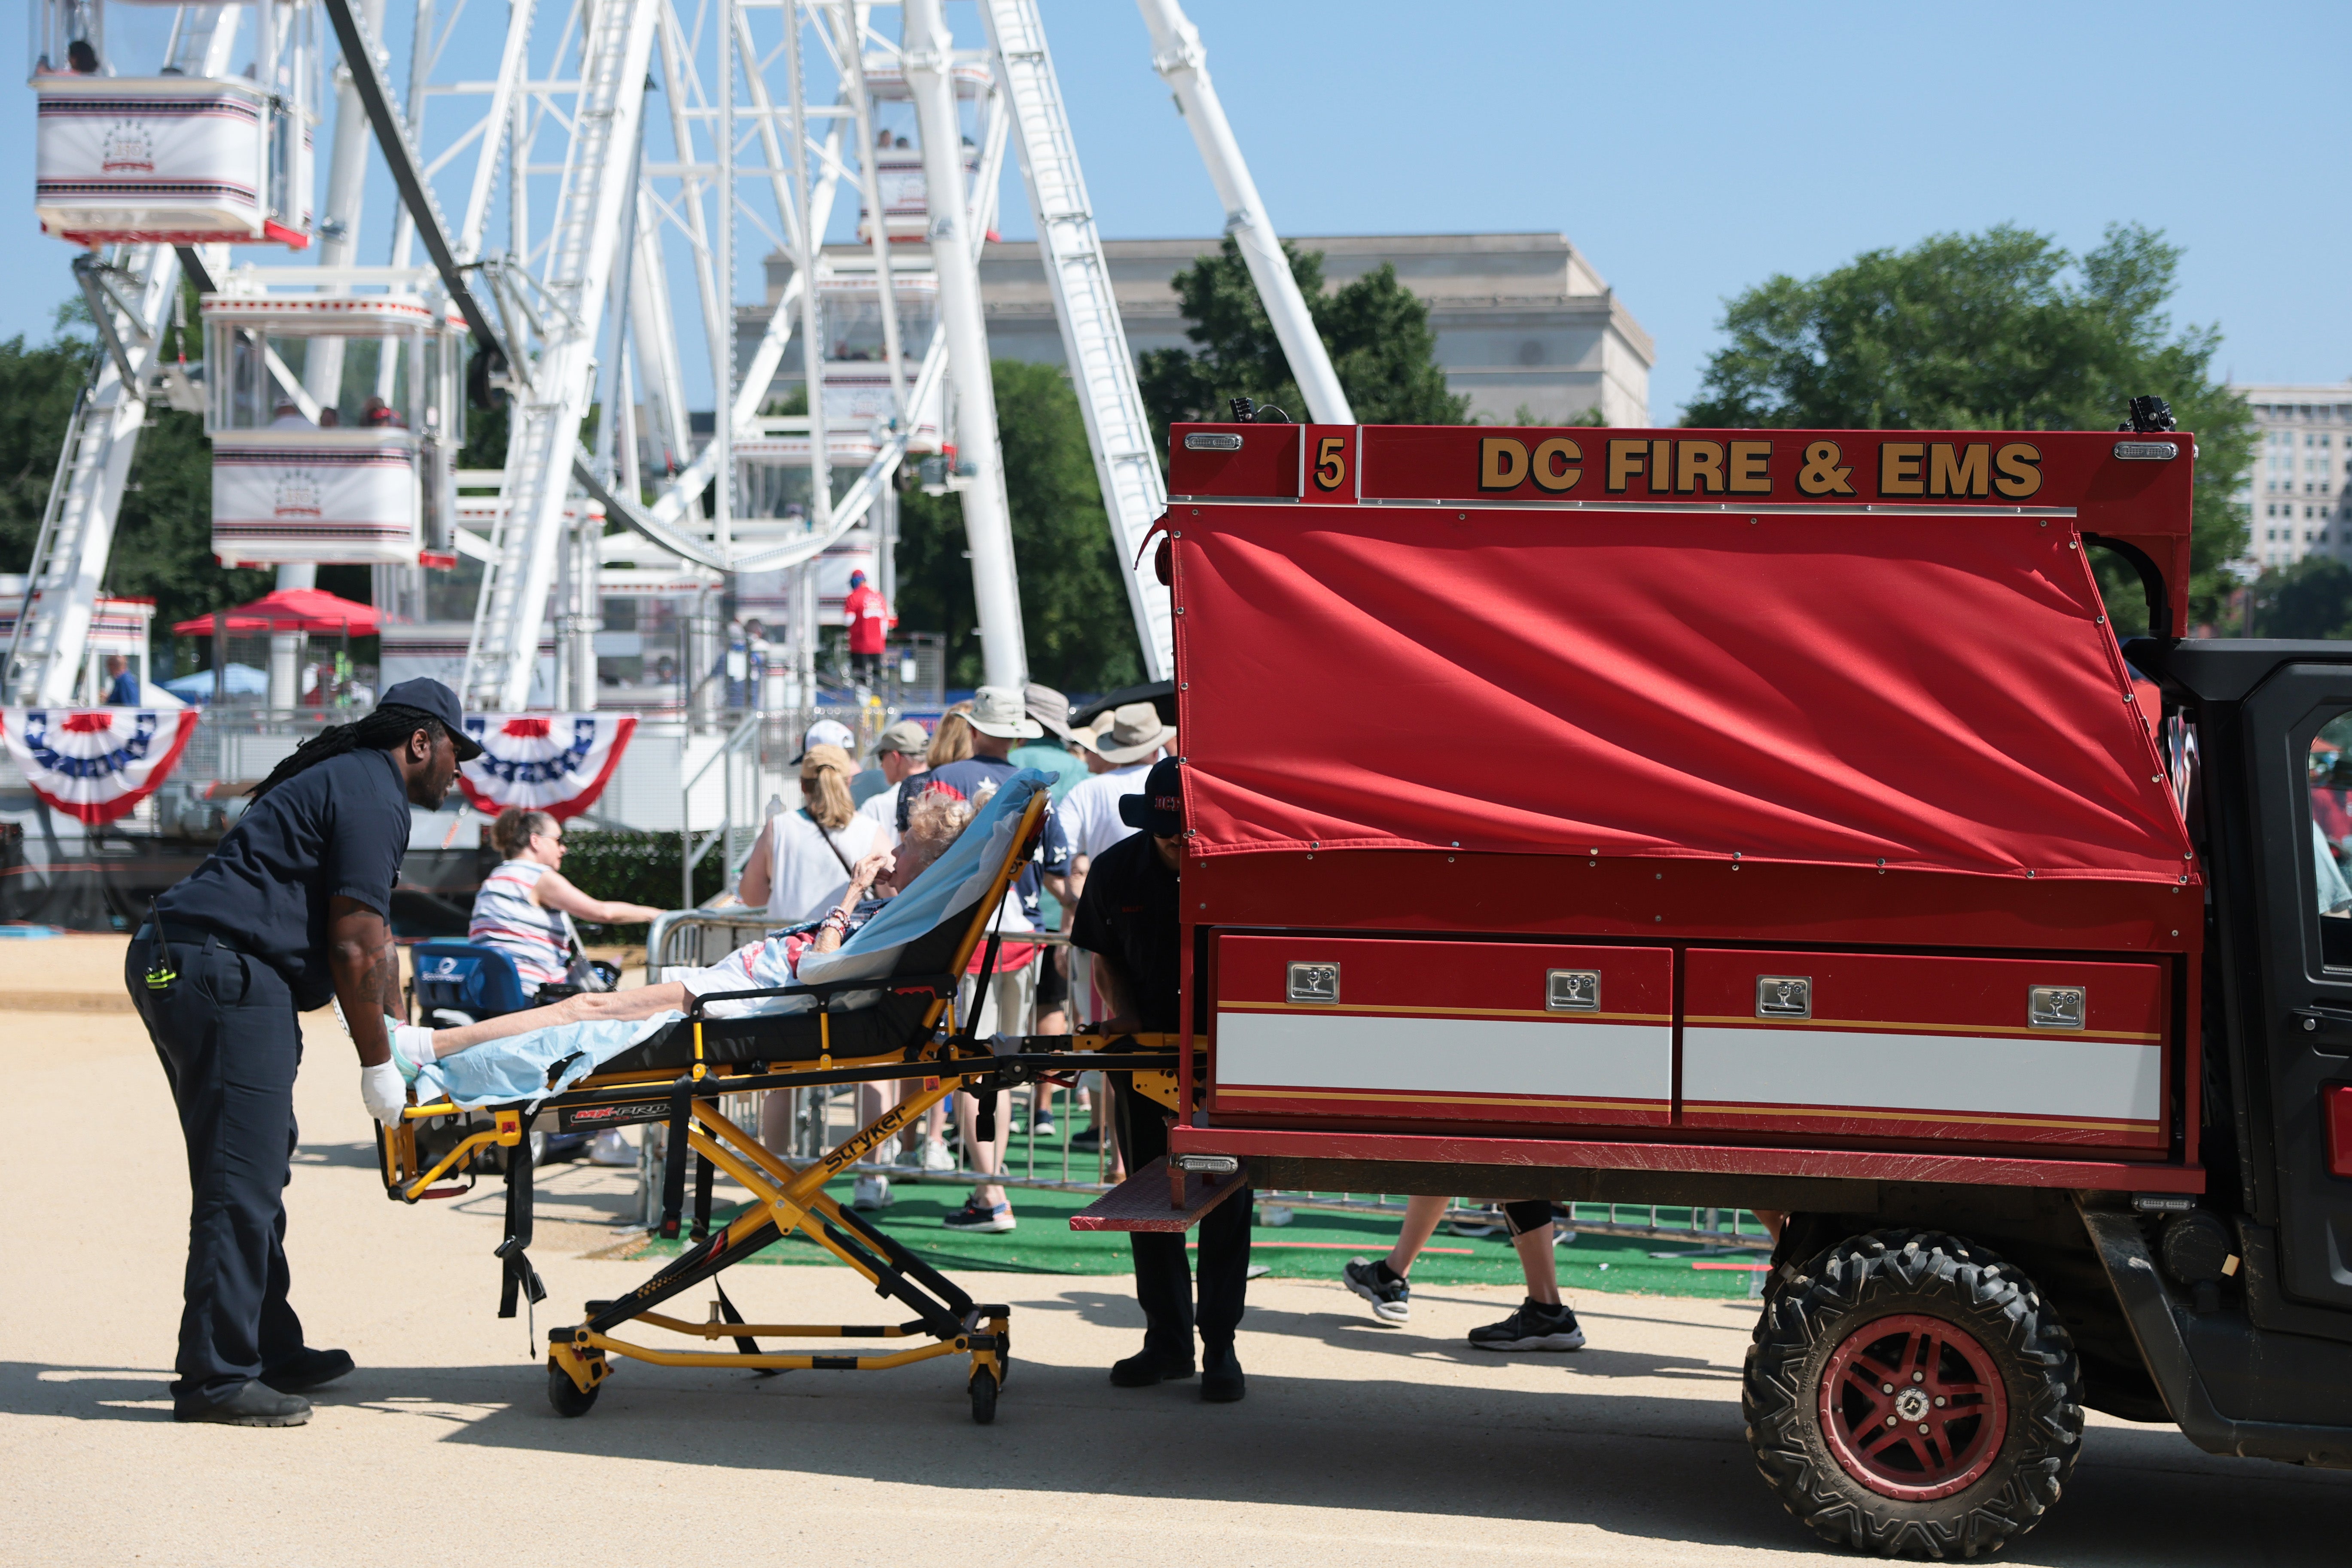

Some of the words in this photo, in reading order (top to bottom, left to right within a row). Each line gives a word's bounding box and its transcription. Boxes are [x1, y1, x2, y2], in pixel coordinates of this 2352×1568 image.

[1313, 437, 1346, 492] 5
[1478, 437, 1584, 494] DC
[1605, 438, 1773, 496] FIRE
[1794, 440, 1858, 498] &
[1877, 442, 2043, 500] EMS
[576, 1103, 667, 1119] MX-PRO
